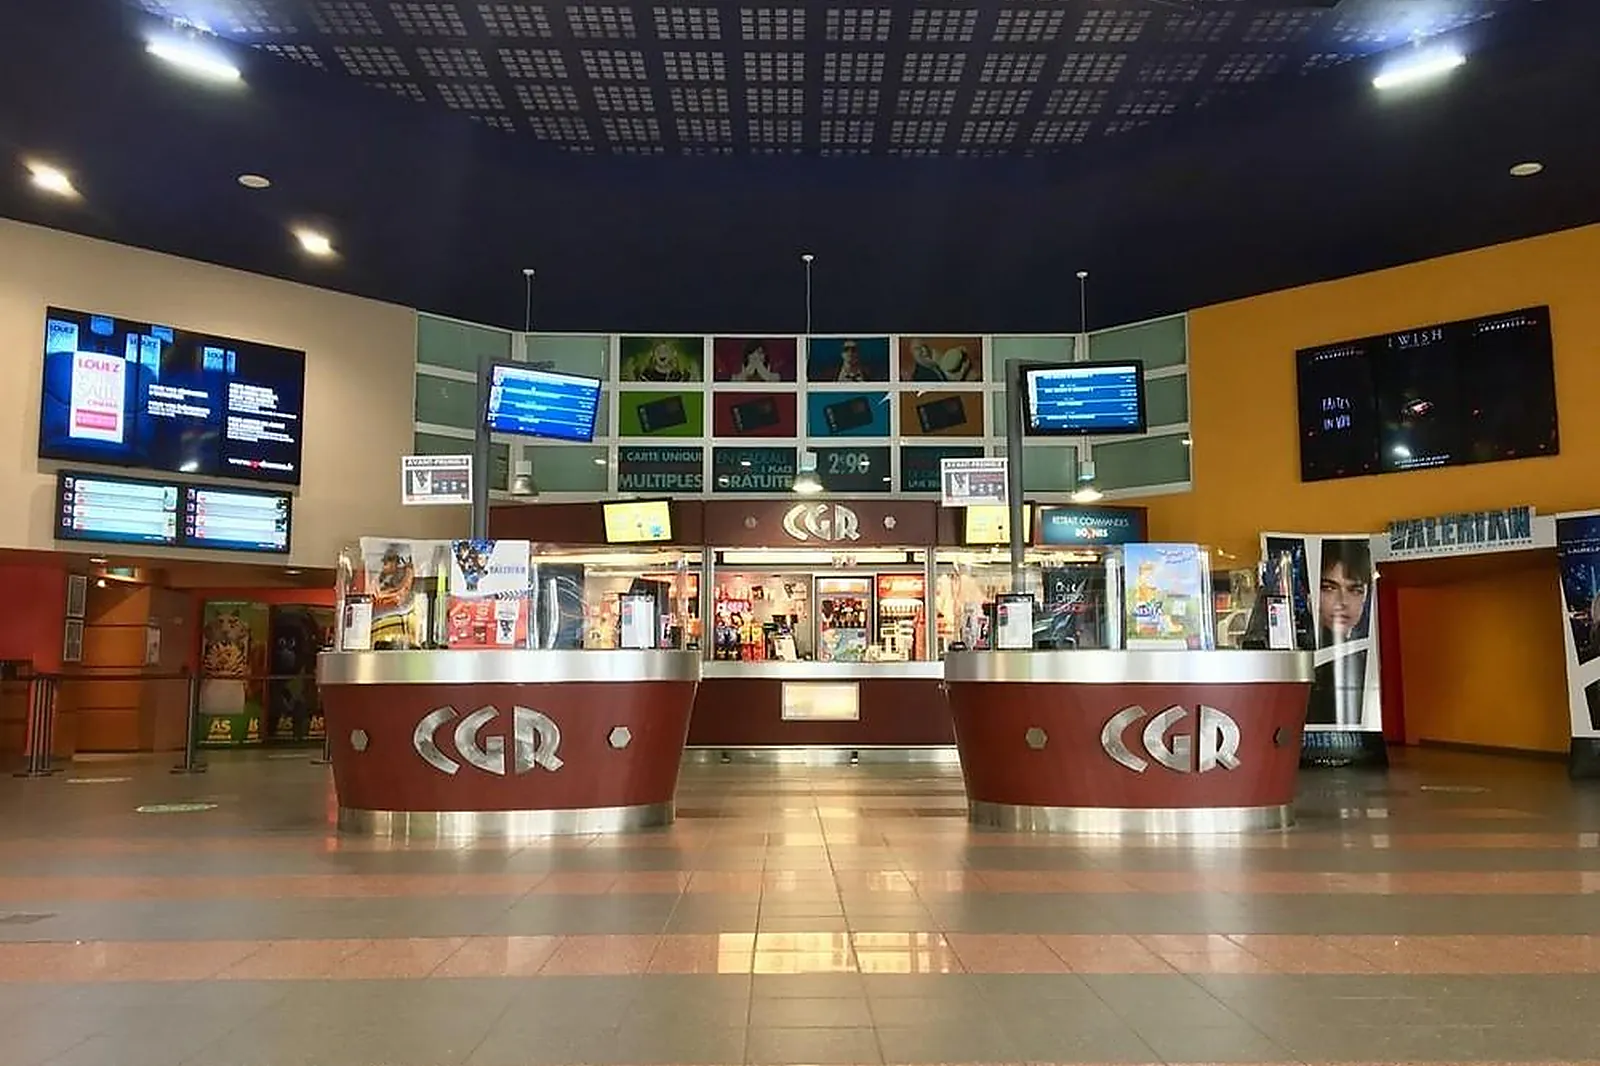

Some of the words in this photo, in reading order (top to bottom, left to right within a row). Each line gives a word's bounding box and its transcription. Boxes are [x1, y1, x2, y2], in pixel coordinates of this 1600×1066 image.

[1397, 328, 1443, 346] WISH
[619, 473, 702, 489] MULTIPLES
[783, 503, 861, 541] CGR
[1389, 505, 1531, 551] VALERIAN
[413, 705, 564, 776] CGR
[1100, 704, 1243, 774] CGR
